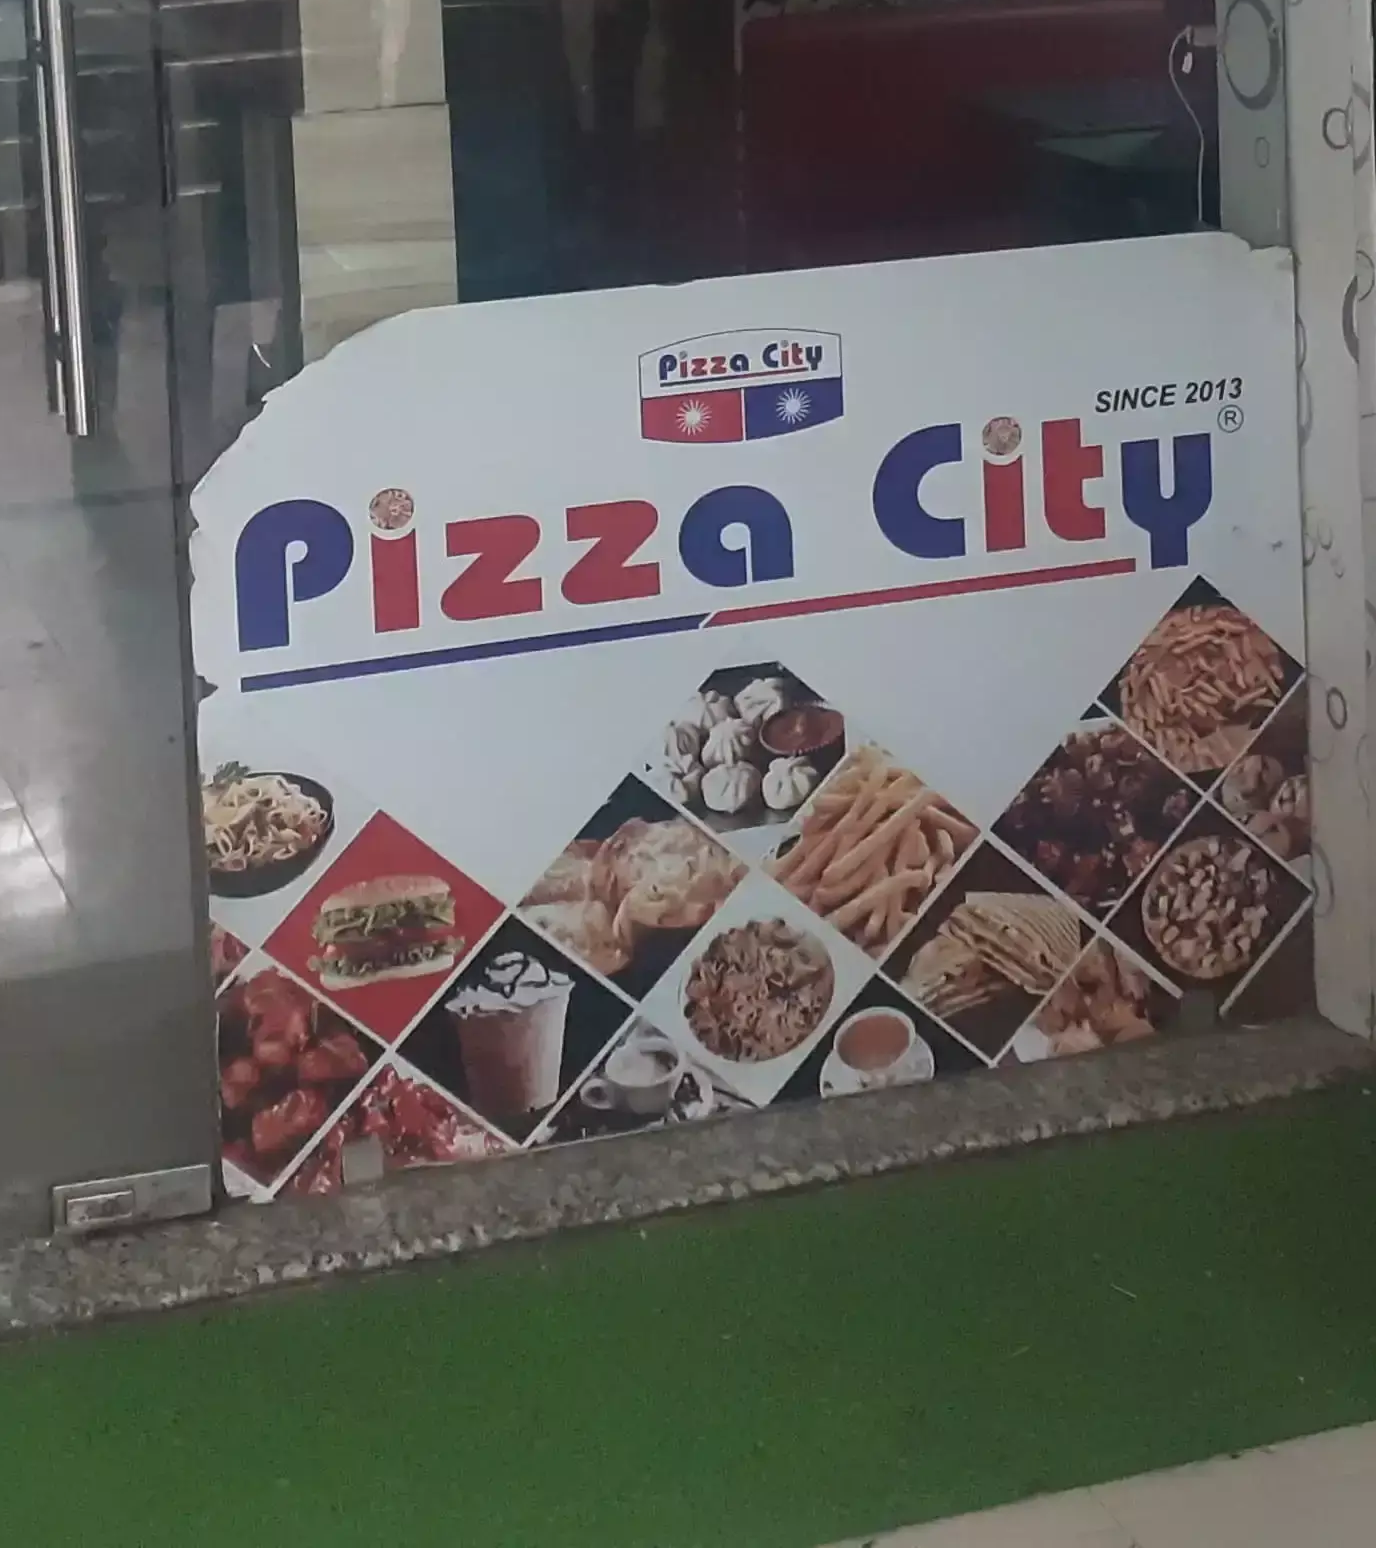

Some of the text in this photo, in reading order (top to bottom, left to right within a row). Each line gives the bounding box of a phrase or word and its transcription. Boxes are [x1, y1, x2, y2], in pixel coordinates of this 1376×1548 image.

[659, 339, 823, 381] Pizza City
[1094, 377, 1243, 414] SINCE 2013
[234, 415, 1212, 653] Pizza City
